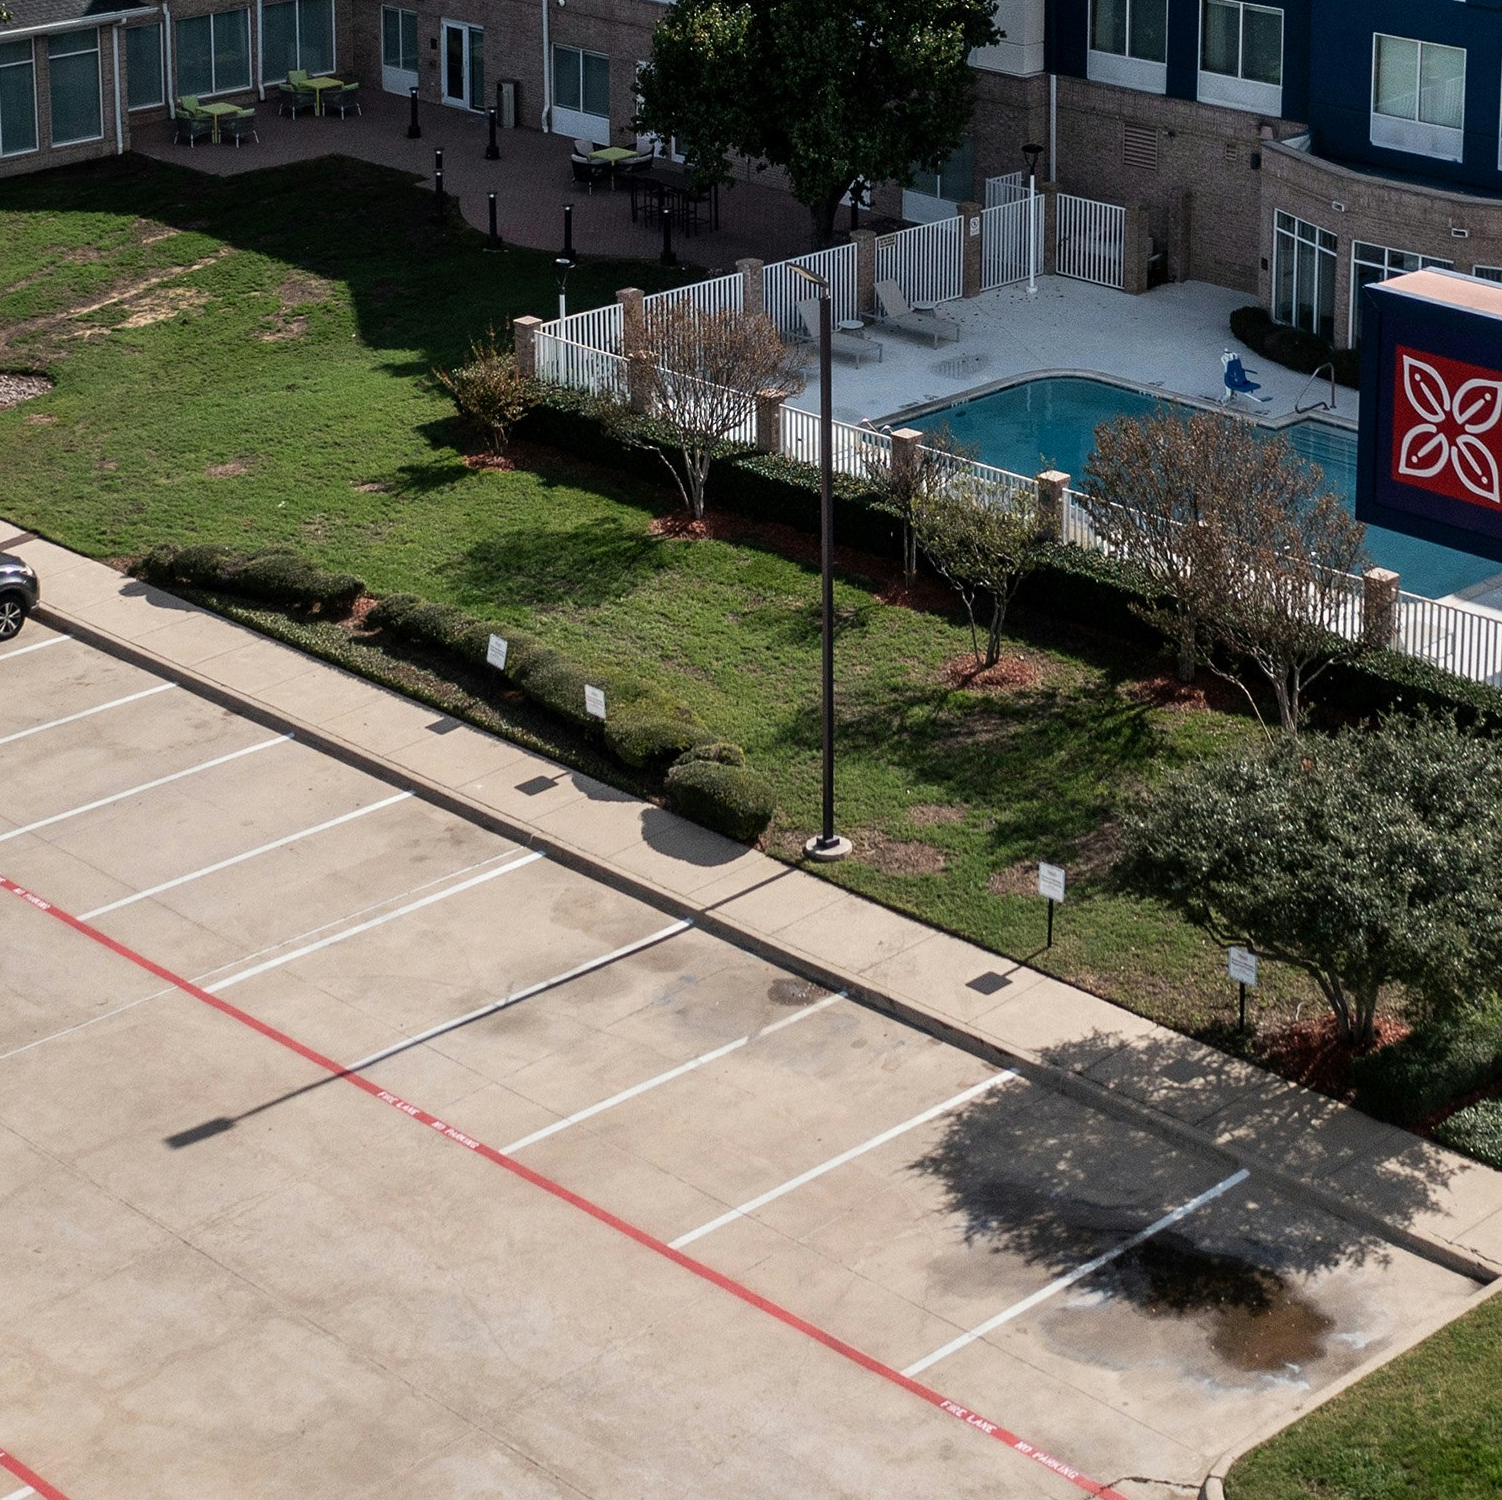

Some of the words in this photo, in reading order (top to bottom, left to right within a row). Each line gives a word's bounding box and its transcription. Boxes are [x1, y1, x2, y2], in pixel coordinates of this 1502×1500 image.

[377, 1091, 399, 1104] FIRE
[396, 1101, 420, 1116] LANE
[940, 1400, 967, 1417] FIRE
[966, 1414, 997, 1433] LANE
[1014, 1441, 1033, 1453] NO
[1032, 1452, 1079, 1480] PARKING
